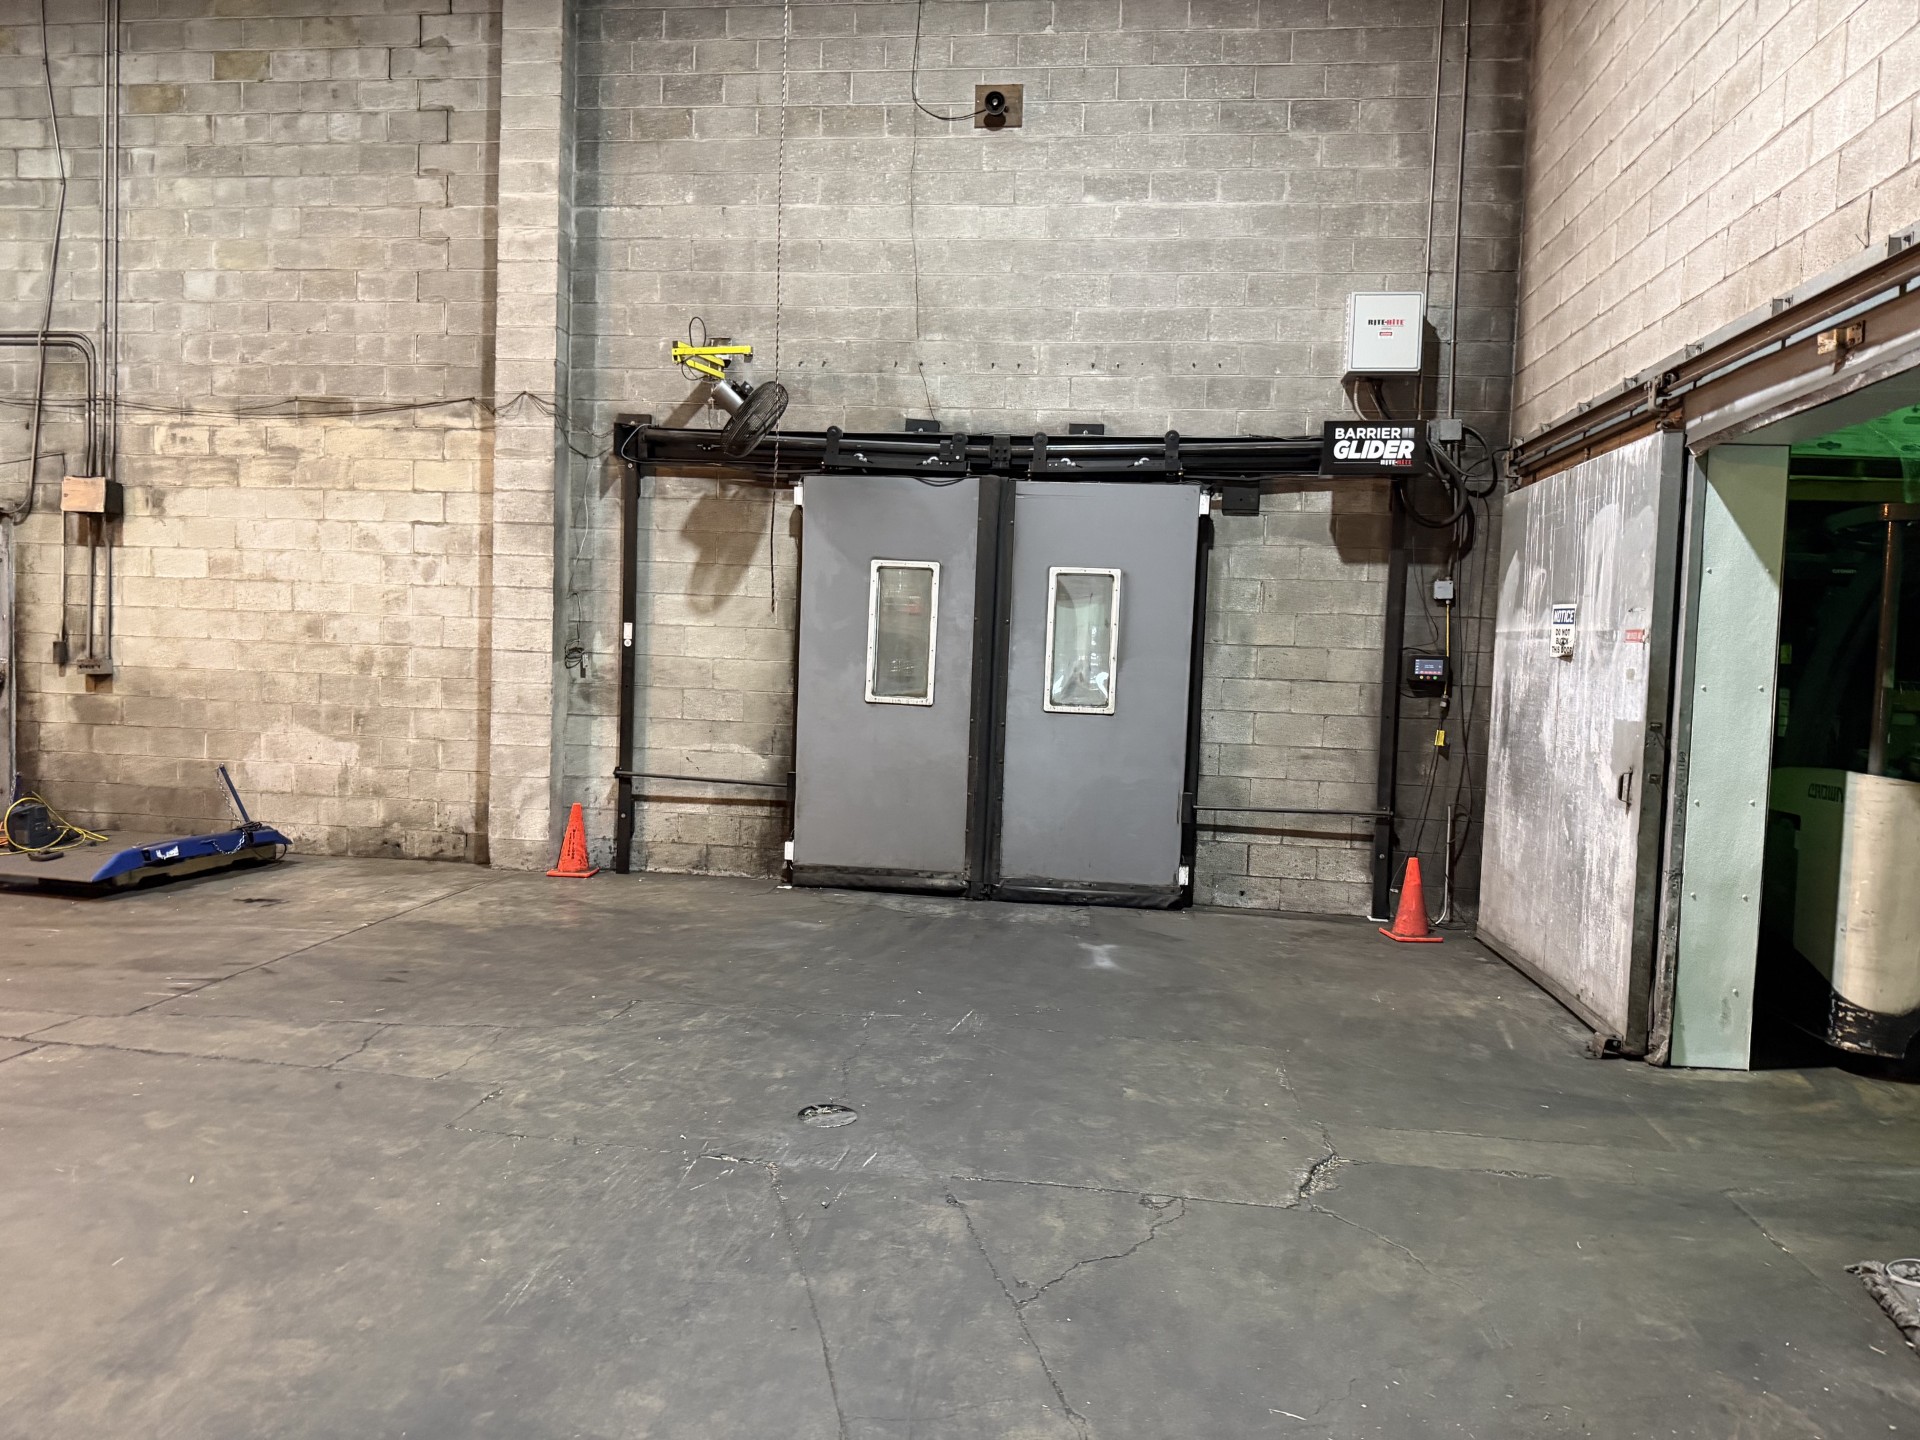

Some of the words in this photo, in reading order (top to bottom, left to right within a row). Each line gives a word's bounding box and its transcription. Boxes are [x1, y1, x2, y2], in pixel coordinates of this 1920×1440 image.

[1335, 428, 1401, 439] BARRIER
[1333, 440, 1415, 459] GLIDER
[1554, 610, 1575, 622] NOTICE
[1808, 784, 1843, 802] CROWN
